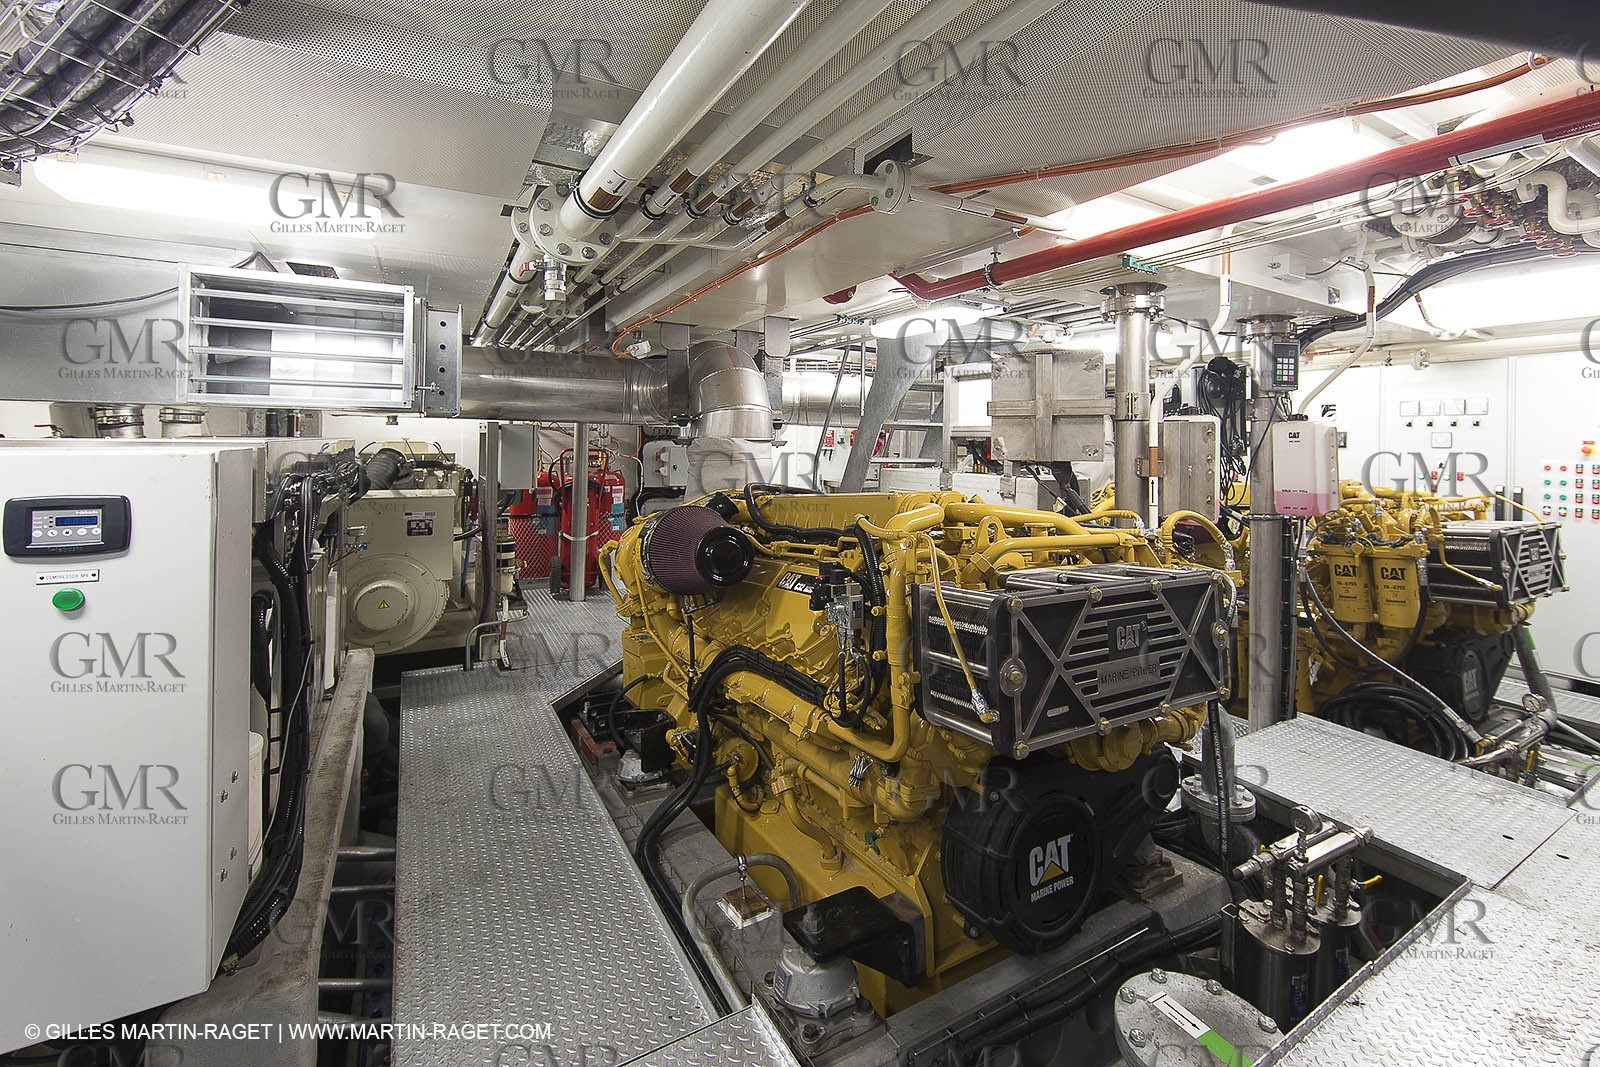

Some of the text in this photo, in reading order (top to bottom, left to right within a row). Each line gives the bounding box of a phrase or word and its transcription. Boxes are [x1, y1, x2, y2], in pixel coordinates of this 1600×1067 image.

[1288, 431, 1301, 439] CAT
[1334, 564, 1358, 577] CAT
[1381, 567, 1407, 580] CAT
[778, 573, 803, 590] CAT
[1116, 623, 1141, 651] CAT
[1099, 663, 1158, 686] MARINE POWER
[1029, 834, 1072, 887] CAT
[1030, 875, 1075, 903] MARINE POWER
